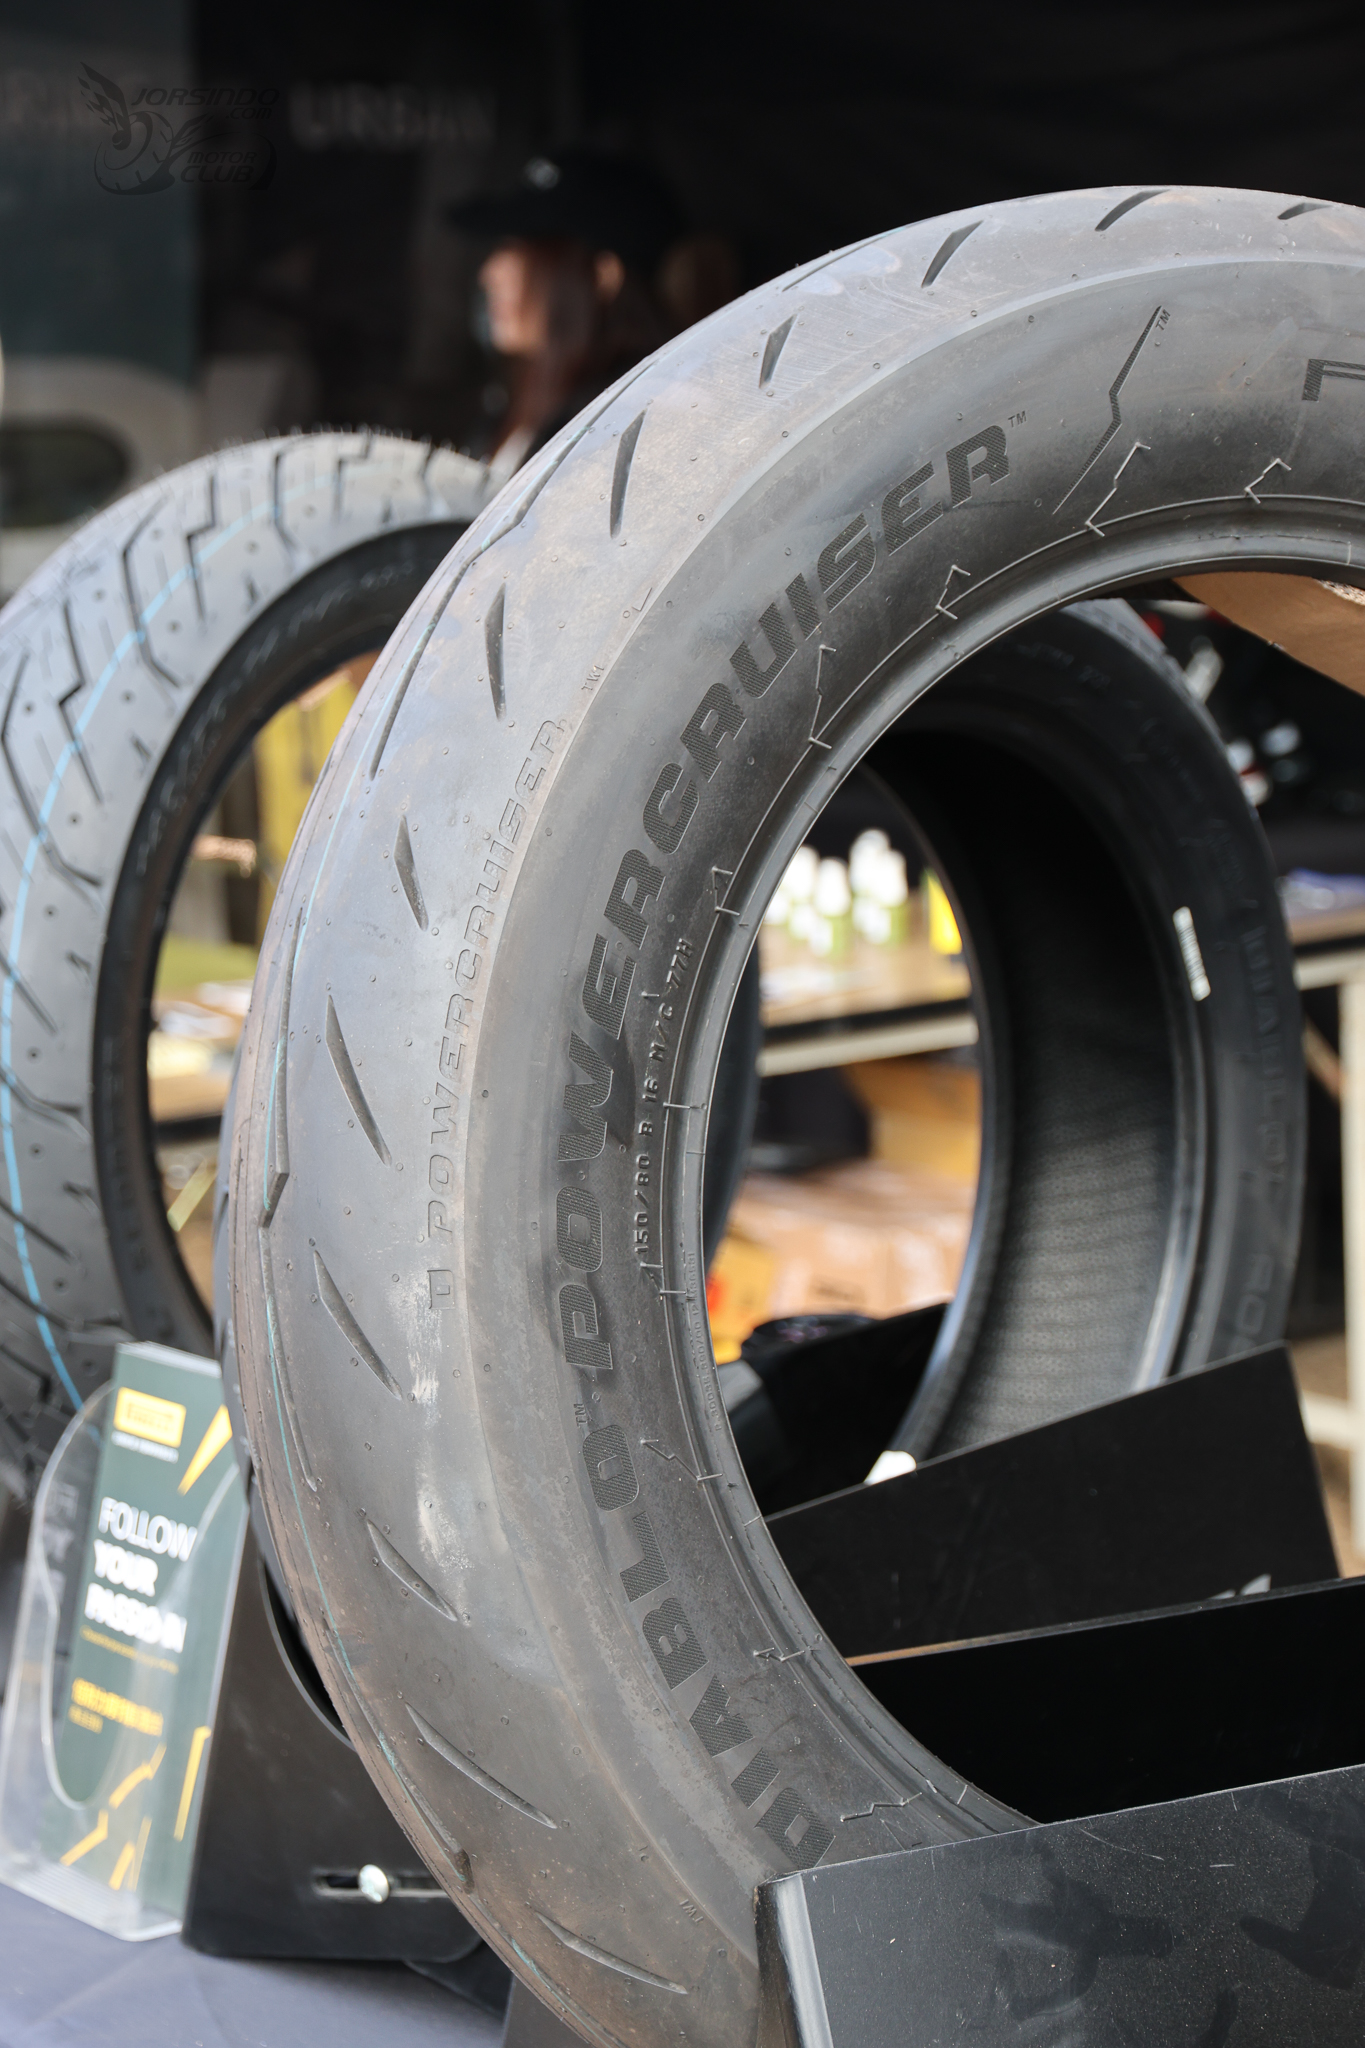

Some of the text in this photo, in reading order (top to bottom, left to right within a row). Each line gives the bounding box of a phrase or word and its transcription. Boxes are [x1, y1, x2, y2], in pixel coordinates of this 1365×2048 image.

[555, 425, 1010, 1370] POWERCRUISER
[427, 719, 565, 1241] POWERCRUISER
[665, 937, 693, 989] 77H
[648, 1002, 674, 1063] M/C
[641, 1077, 659, 1103] 16
[633, 1153, 651, 1255] 150/80
[98, 1496, 198, 1562] FOLLOW
[93, 1539, 159, 1597] YOUR
[583, 1425, 837, 1869] DIABLO
